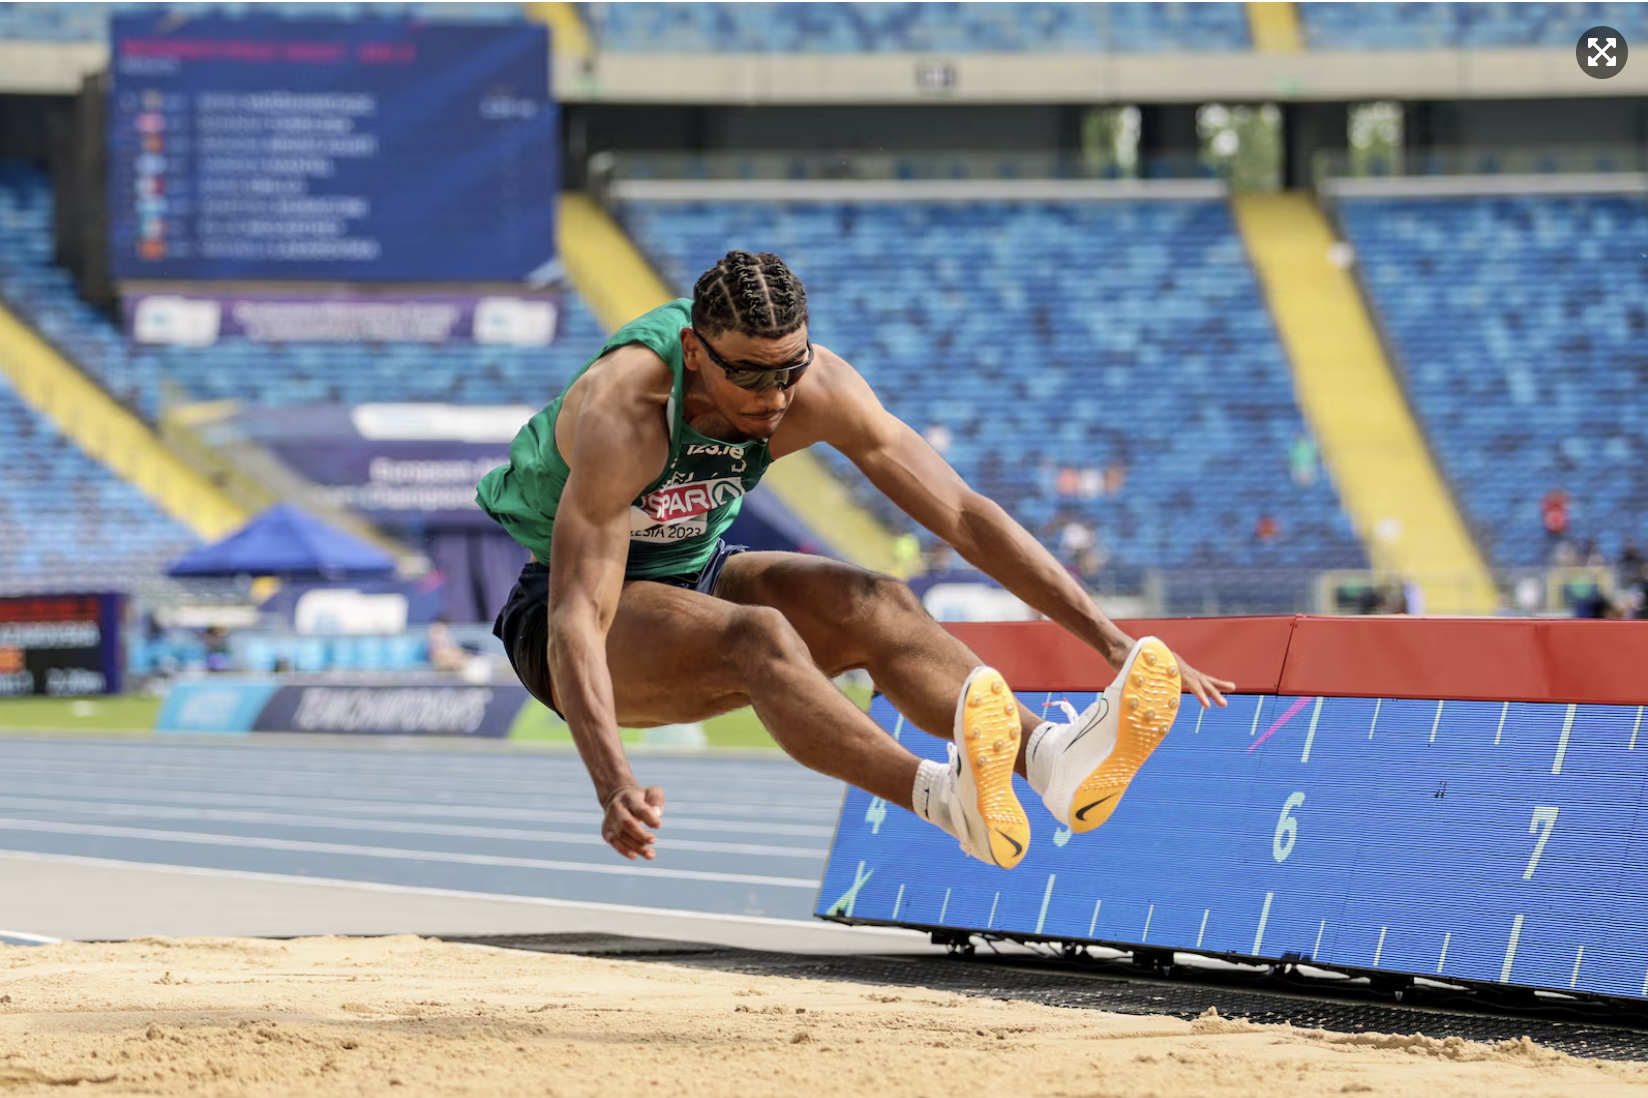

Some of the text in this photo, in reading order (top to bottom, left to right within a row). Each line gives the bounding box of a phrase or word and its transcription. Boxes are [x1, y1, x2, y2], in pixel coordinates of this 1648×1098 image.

[645, 489, 711, 518] SPAR
[667, 525, 702, 539] 2023
[864, 791, 1560, 880] 4 6 7
